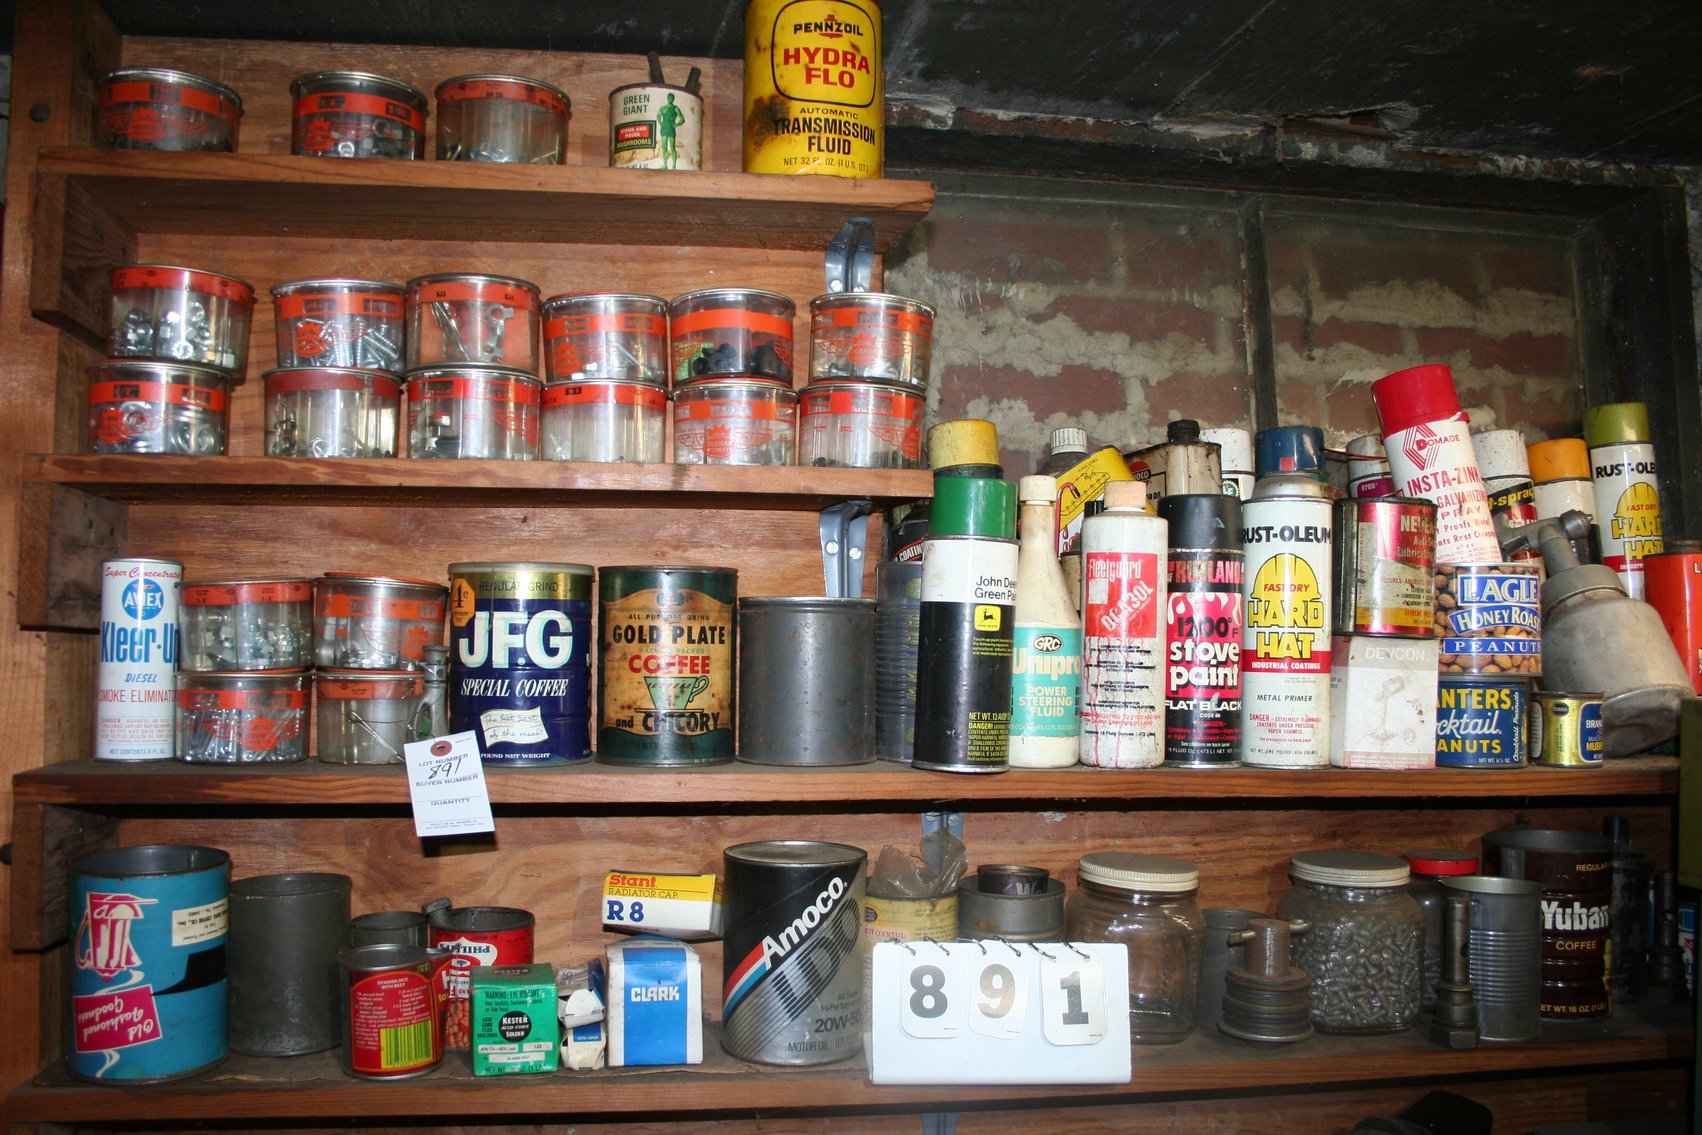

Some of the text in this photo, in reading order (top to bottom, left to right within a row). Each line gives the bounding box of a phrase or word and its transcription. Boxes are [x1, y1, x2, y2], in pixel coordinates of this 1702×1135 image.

[793, 21, 863, 37] PENNZOIL
[783, 47, 871, 75] HYDRA
[805, 67, 855, 89] FLO
[623, 94, 650, 106] GREEN
[623, 104, 648, 115] GIANT
[799, 107, 859, 120] AUTOMATIC
[773, 117, 876, 145] TRANSMISSION
[616, 138, 652, 148] MUSHROOMS
[807, 136, 852, 156] FLUID
[783, 157, 798, 167] NET
[800, 157, 811, 165] 32
[824, 158, 836, 167] OZ.
[843, 159, 857, 170] U.S.
[858, 162, 869, 173] QT)
[1415, 434, 1461, 452] DOMADE
[1152, 491, 1162, 500] OIL
[1437, 505, 1481, 520] PRAY
[1626, 503, 1657, 512] FAST DRY
[1443, 520, 1471, 533] Proofs
[1623, 540, 1664, 562] HAT
[105, 566, 181, 579] Super Cncentrat
[480, 581, 559, 592] REGULA GRIND
[975, 575, 1003, 587] John
[974, 587, 1006, 600] Green
[1263, 583, 1311, 593] FAST DRY
[1247, 600, 1325, 629] HARD
[1456, 609, 1510, 631] HONEY
[612, 624, 726, 645] GOLD PLATE
[1033, 636, 1061, 651] GRC
[1169, 638, 1240, 662] stove
[1256, 631, 1315, 660] HAT
[1454, 641, 1541, 653] PEANUTS
[1365, 647, 1425, 661] DEVCON
[628, 654, 711, 675] COFFEE
[1251, 661, 1321, 670] INDUSTRIAL COATINGS
[125, 673, 158, 683] DIESEL
[1169, 658, 1239, 692] paint
[461, 679, 569, 697] SPECIAL COFFEE
[1027, 686, 1068, 697] POWER
[99, 689, 127, 703] SMOKE
[1018, 696, 1073, 707] STEERING
[1256, 694, 1313, 702] METAL PRIMER
[1030, 706, 1065, 717] FLUID
[1165, 700, 1198, 710] FLAT
[1199, 700, 1242, 711] BLACK
[483, 714, 497, 725] The
[499, 713, 514, 722] best
[615, 712, 721, 732] and CHICORY
[968, 711, 998, 721] NET WT. 13
[1249, 713, 1270, 722] DANGER
[501, 729, 515, 737] the
[1512, 691, 1520, 762] Cocktail Peanuts
[435, 752, 469, 765] NUMBER
[428, 758, 462, 780] 891
[444, 773, 479, 785] NUMBER
[430, 796, 471, 806] QUANTITY
[608, 874, 657, 888] Stant
[607, 887, 679, 899] RADIATOR CAP
[606, 899, 645, 922] R 8
[1540, 900, 1609, 931] Yuban
[761, 876, 845, 972] Amoco
[875, 930, 906, 939] COCKTAIL
[439, 943, 490, 954] PHILIPS
[1555, 940, 1597, 951] COFFEE
[509, 991, 518, 999] EYE
[630, 986, 680, 1003] CLARK
[77, 995, 125, 1024] Goodness
[1553, 1004, 1567, 1013] WT.
[83, 1007, 145, 1044] Fashioned
[502, 1016, 528, 1025] KESTER
[129, 1017, 154, 1042] Old
[787, 1041, 817, 1052] MOTOR
[818, 1040, 828, 1051] OIL
